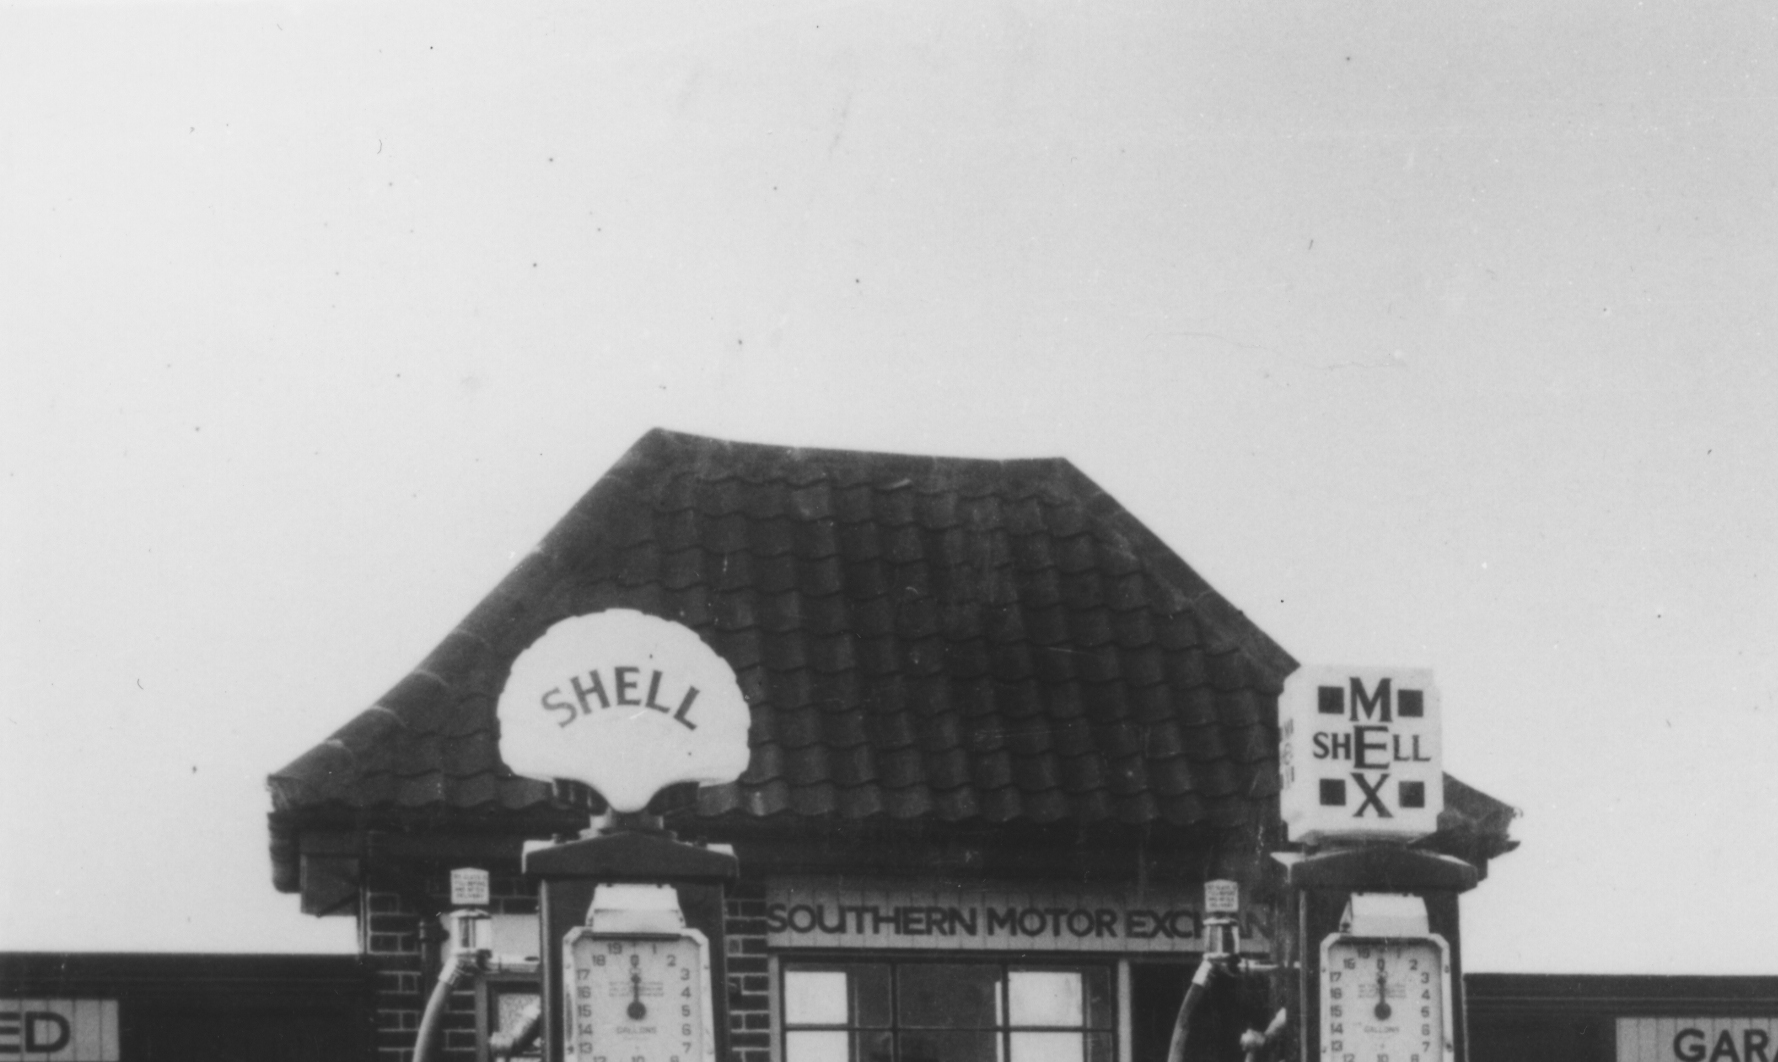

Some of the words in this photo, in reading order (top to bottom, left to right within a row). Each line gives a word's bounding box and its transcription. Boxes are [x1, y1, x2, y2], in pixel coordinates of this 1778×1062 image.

[541, 666, 701, 731] SHELL
[767, 903, 977, 936] SOUTHERN
[987, 907, 1117, 937] MOTOR
[667, 954, 676, 967] 2
[1409, 959, 1418, 970] 2
[577, 968, 590, 980] 17
[680, 968, 690, 981] 3
[1330, 971, 1341, 982] 17
[1421, 972, 1430, 983] 3
[577, 986, 591, 999] 16
[681, 986, 691, 998] 4
[1421, 989, 1430, 1000] 4
[577, 1004, 591, 1017] 15
[681, 1004, 690, 1017] 5
[578, 1023, 593, 1036] 14
[682, 1023, 691, 1036] 6
[1330, 1023, 1343, 1034] 14
[578, 1042, 592, 1054] 13
[682, 1042, 691, 1053] 7
[1422, 1041, 1430, 1051] 7
